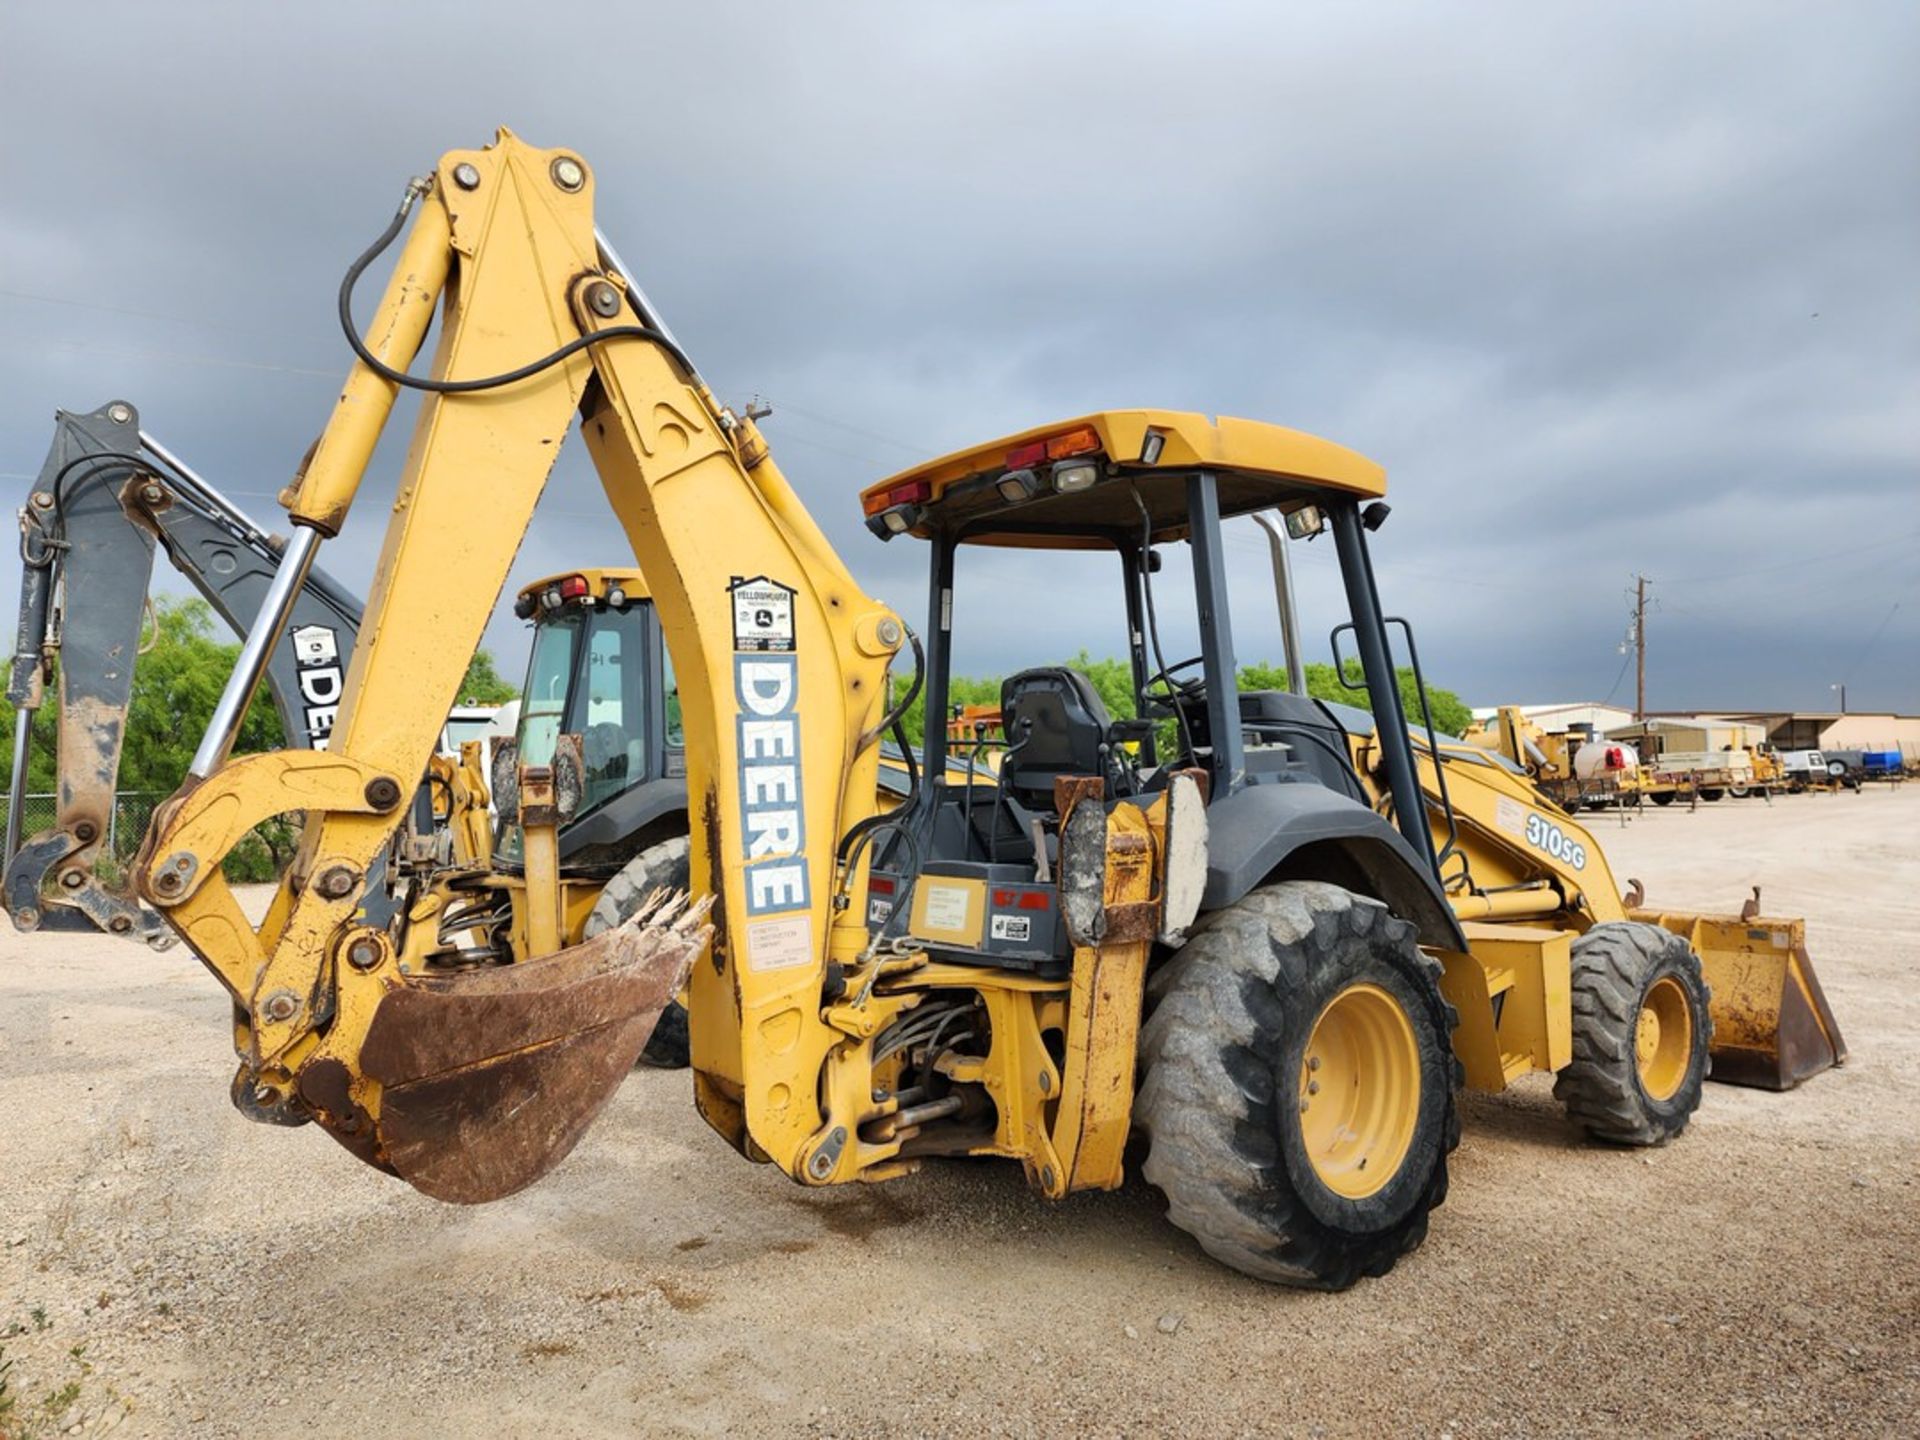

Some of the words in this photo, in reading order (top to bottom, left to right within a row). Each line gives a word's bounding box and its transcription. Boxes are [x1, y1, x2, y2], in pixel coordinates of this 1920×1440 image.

[300, 667, 342, 751] DE
[741, 661, 804, 908] DEERE
[1526, 815, 1585, 870] 310SG
